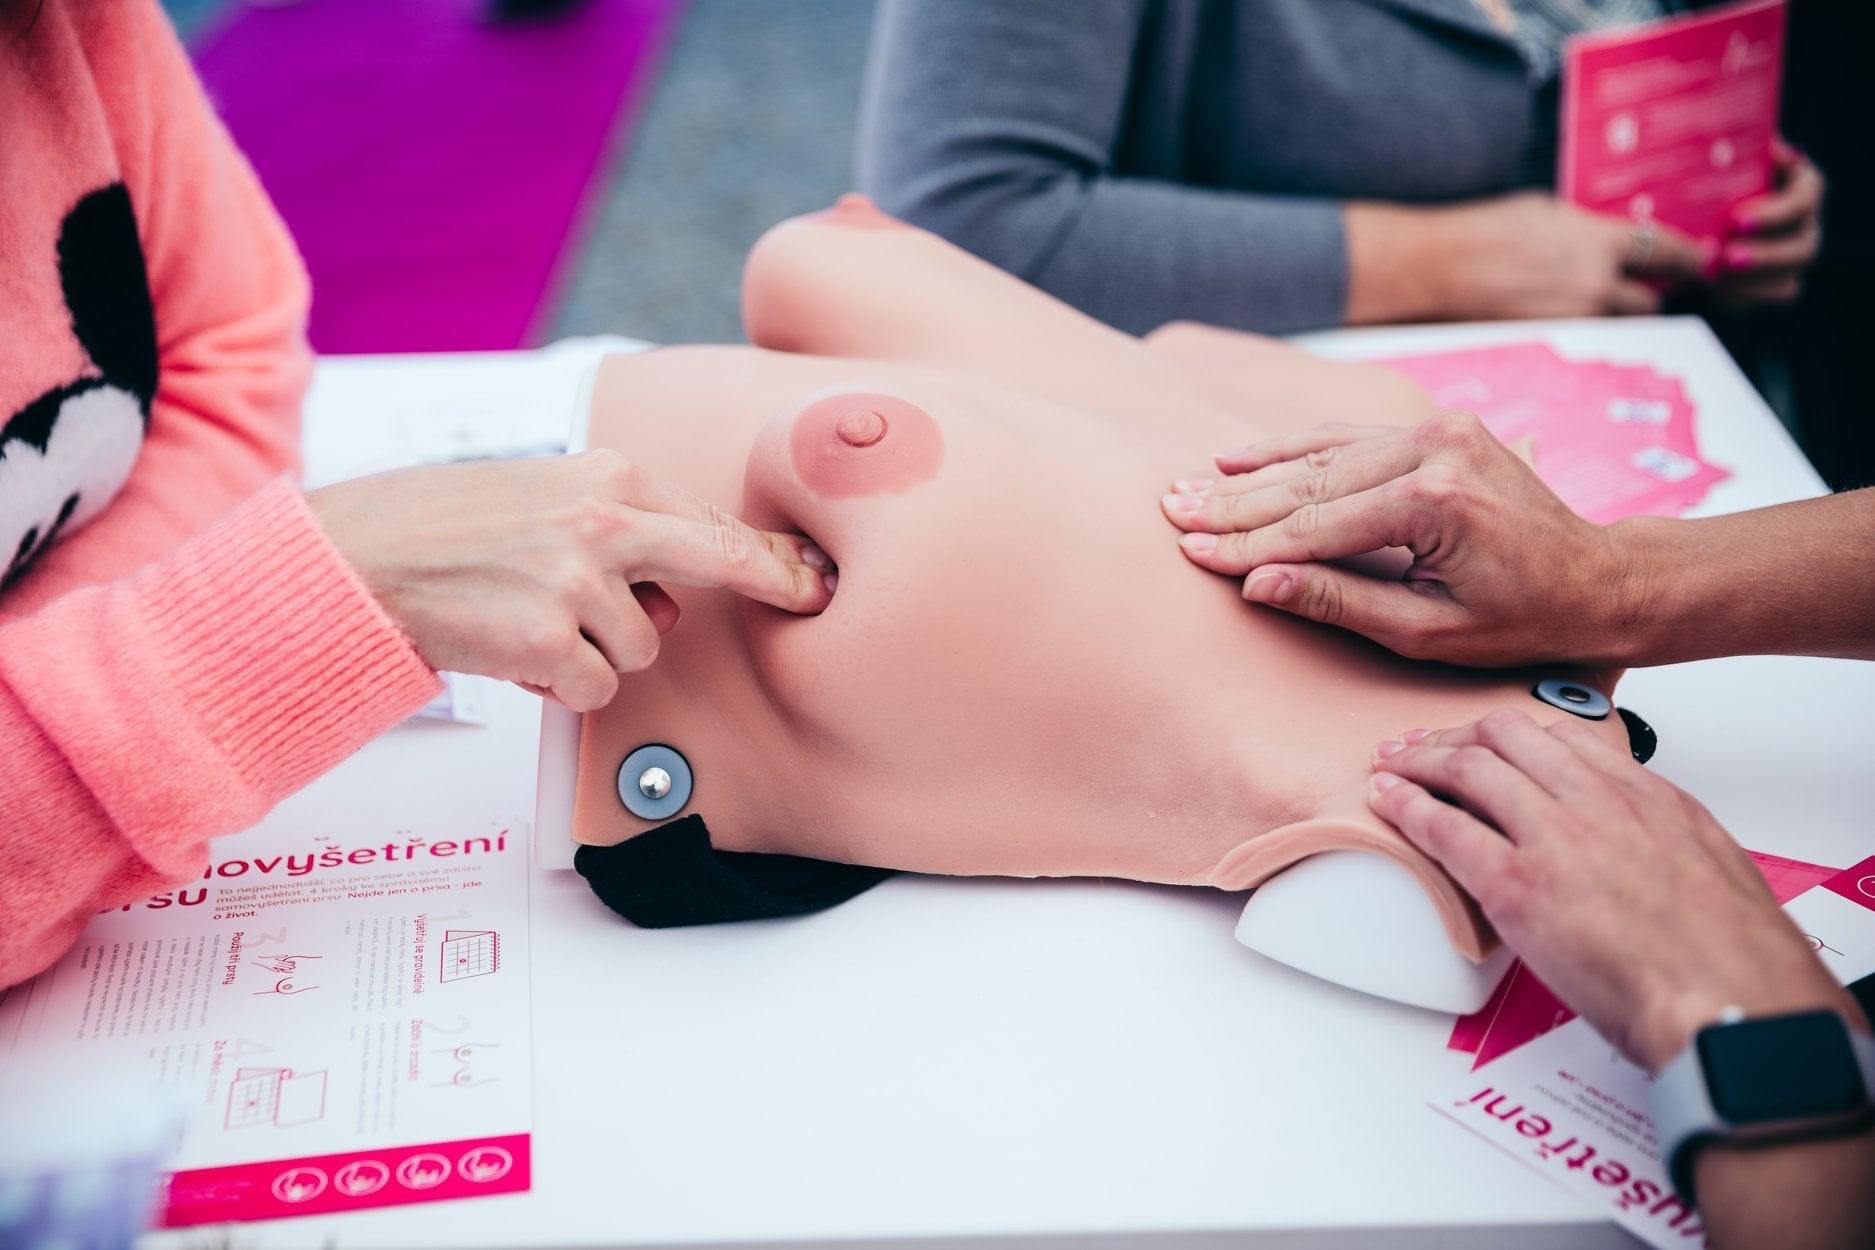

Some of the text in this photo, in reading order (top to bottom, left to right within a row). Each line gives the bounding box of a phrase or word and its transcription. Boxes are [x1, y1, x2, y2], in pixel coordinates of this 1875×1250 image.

[347, 888, 384, 899] Nejde
[387, 886, 407, 896] jen
[421, 883, 451, 893] prsa
[462, 880, 482, 890] jde
[222, 931, 244, 986] Použij tři prsty
[413, 913, 427, 995] Vyšetřuj se pravidelně
